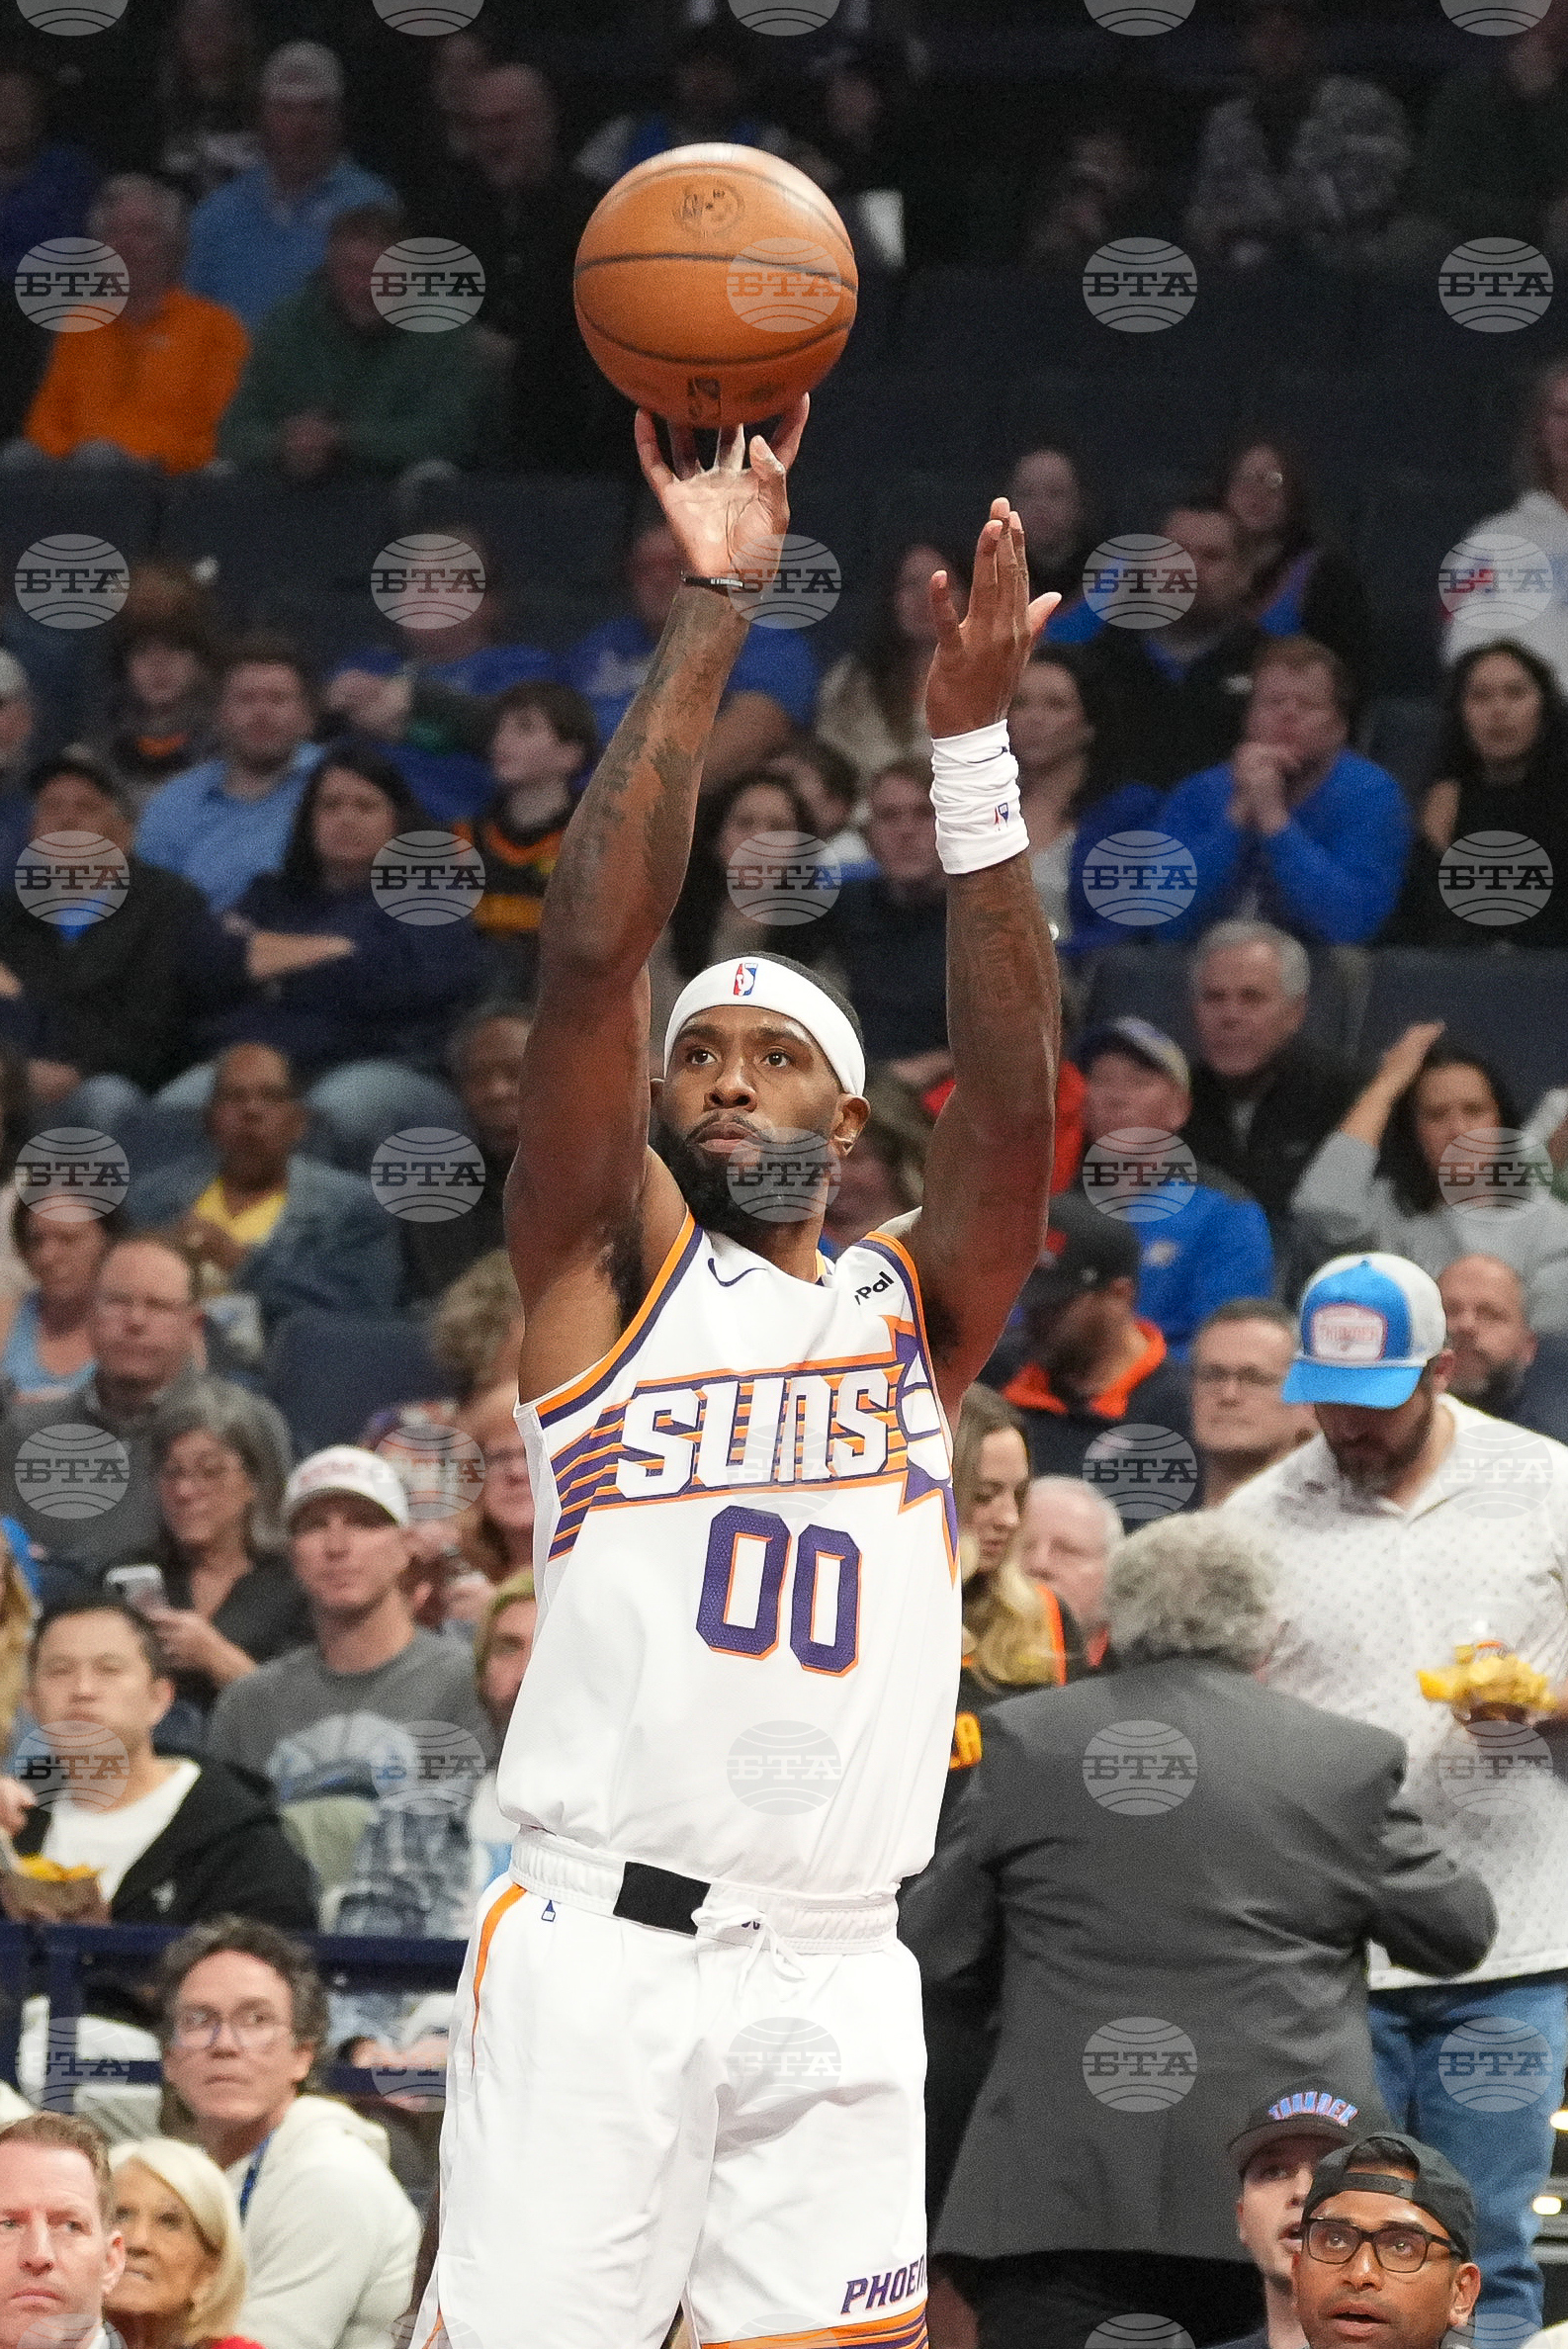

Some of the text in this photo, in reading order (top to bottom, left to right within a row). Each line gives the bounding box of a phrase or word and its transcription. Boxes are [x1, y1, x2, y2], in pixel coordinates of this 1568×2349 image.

[615, 1368, 890, 1500] SUNS
[695, 1505, 863, 1678] 00
[1267, 2090, 1359, 2128] THUNDER
